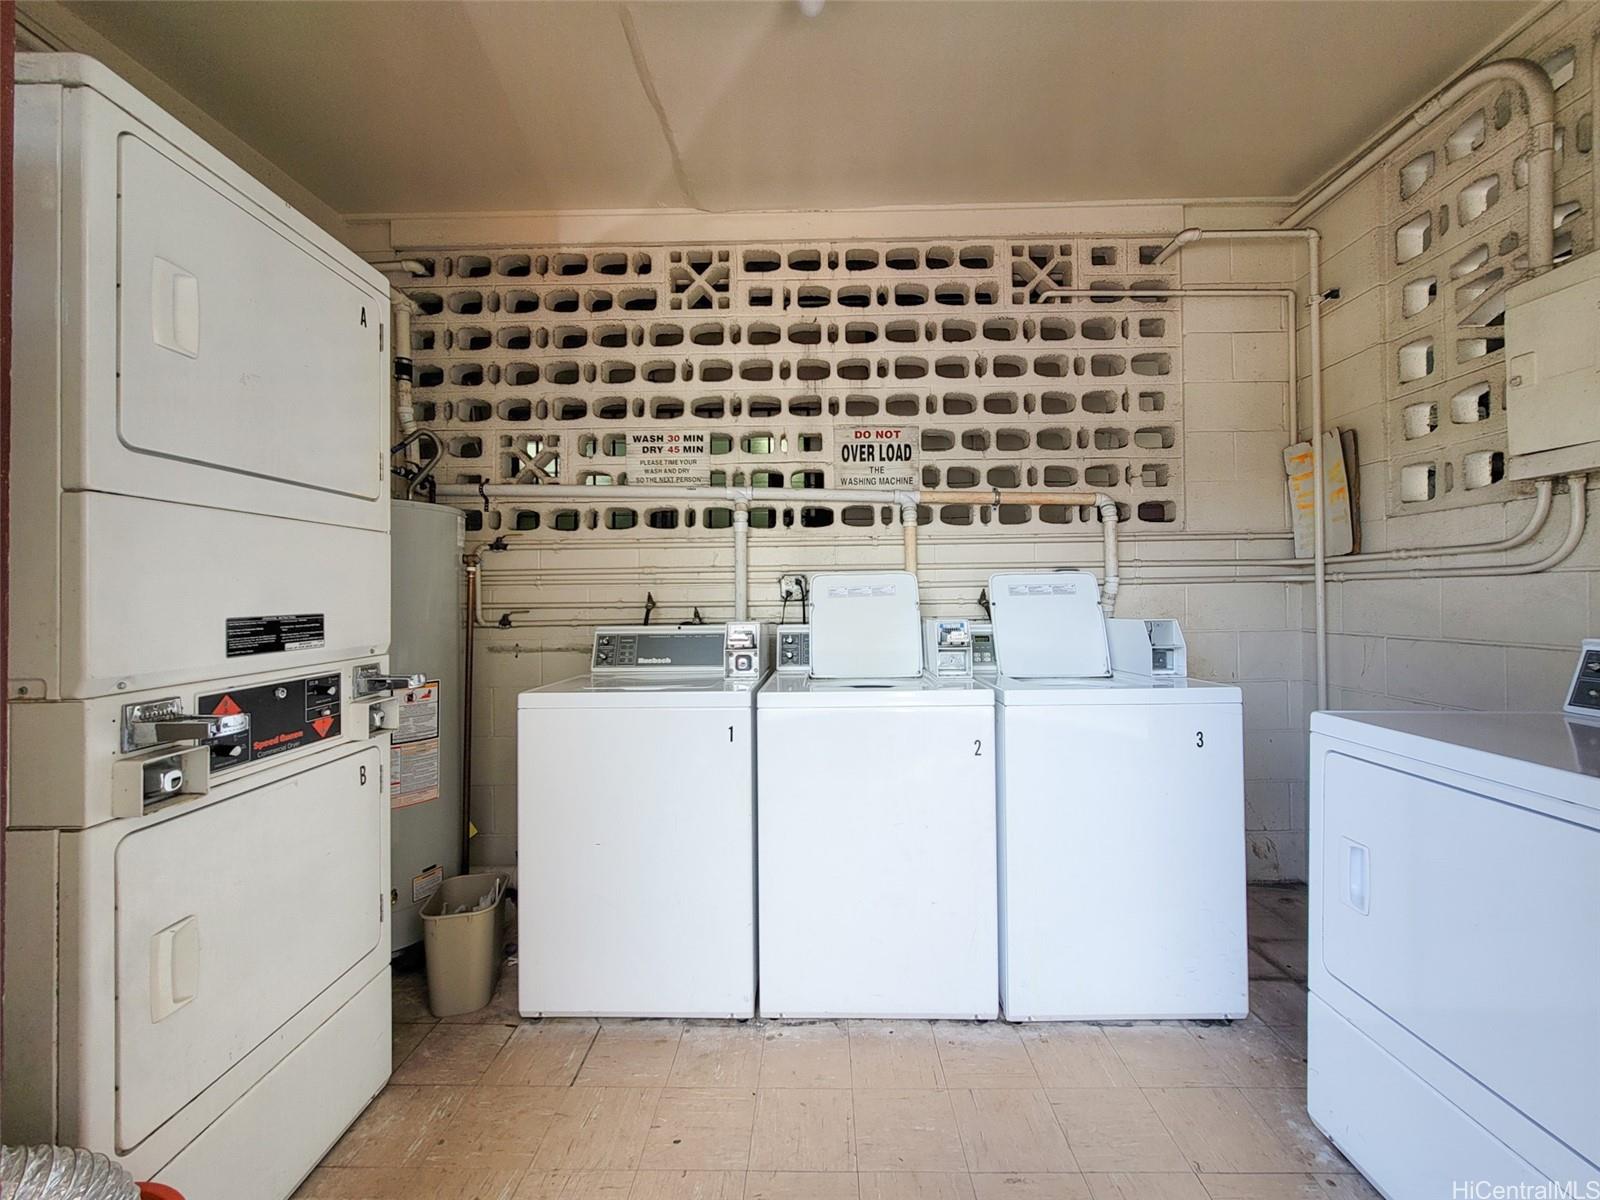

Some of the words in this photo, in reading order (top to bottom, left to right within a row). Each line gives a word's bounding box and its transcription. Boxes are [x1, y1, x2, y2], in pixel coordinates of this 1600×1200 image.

[360, 306, 368, 329] A
[632, 435, 664, 443] WASH
[667, 434, 680, 442] 30
[683, 434, 704, 442] MIN
[854, 430, 871, 439] DO
[875, 430, 901, 439] NOT
[642, 446, 664, 454] DRY
[667, 446, 680, 454] 45
[841, 444, 875, 462] OVER
[879, 444, 912, 461] LOAD
[869, 466, 885, 474] THE
[840, 477, 877, 485] WASHING
[879, 476, 913, 485] MACHINE
[728, 725, 734, 742] 1
[1196, 731, 1204, 748] 3
[974, 739, 982, 756] 2
[359, 765, 367, 786] B
